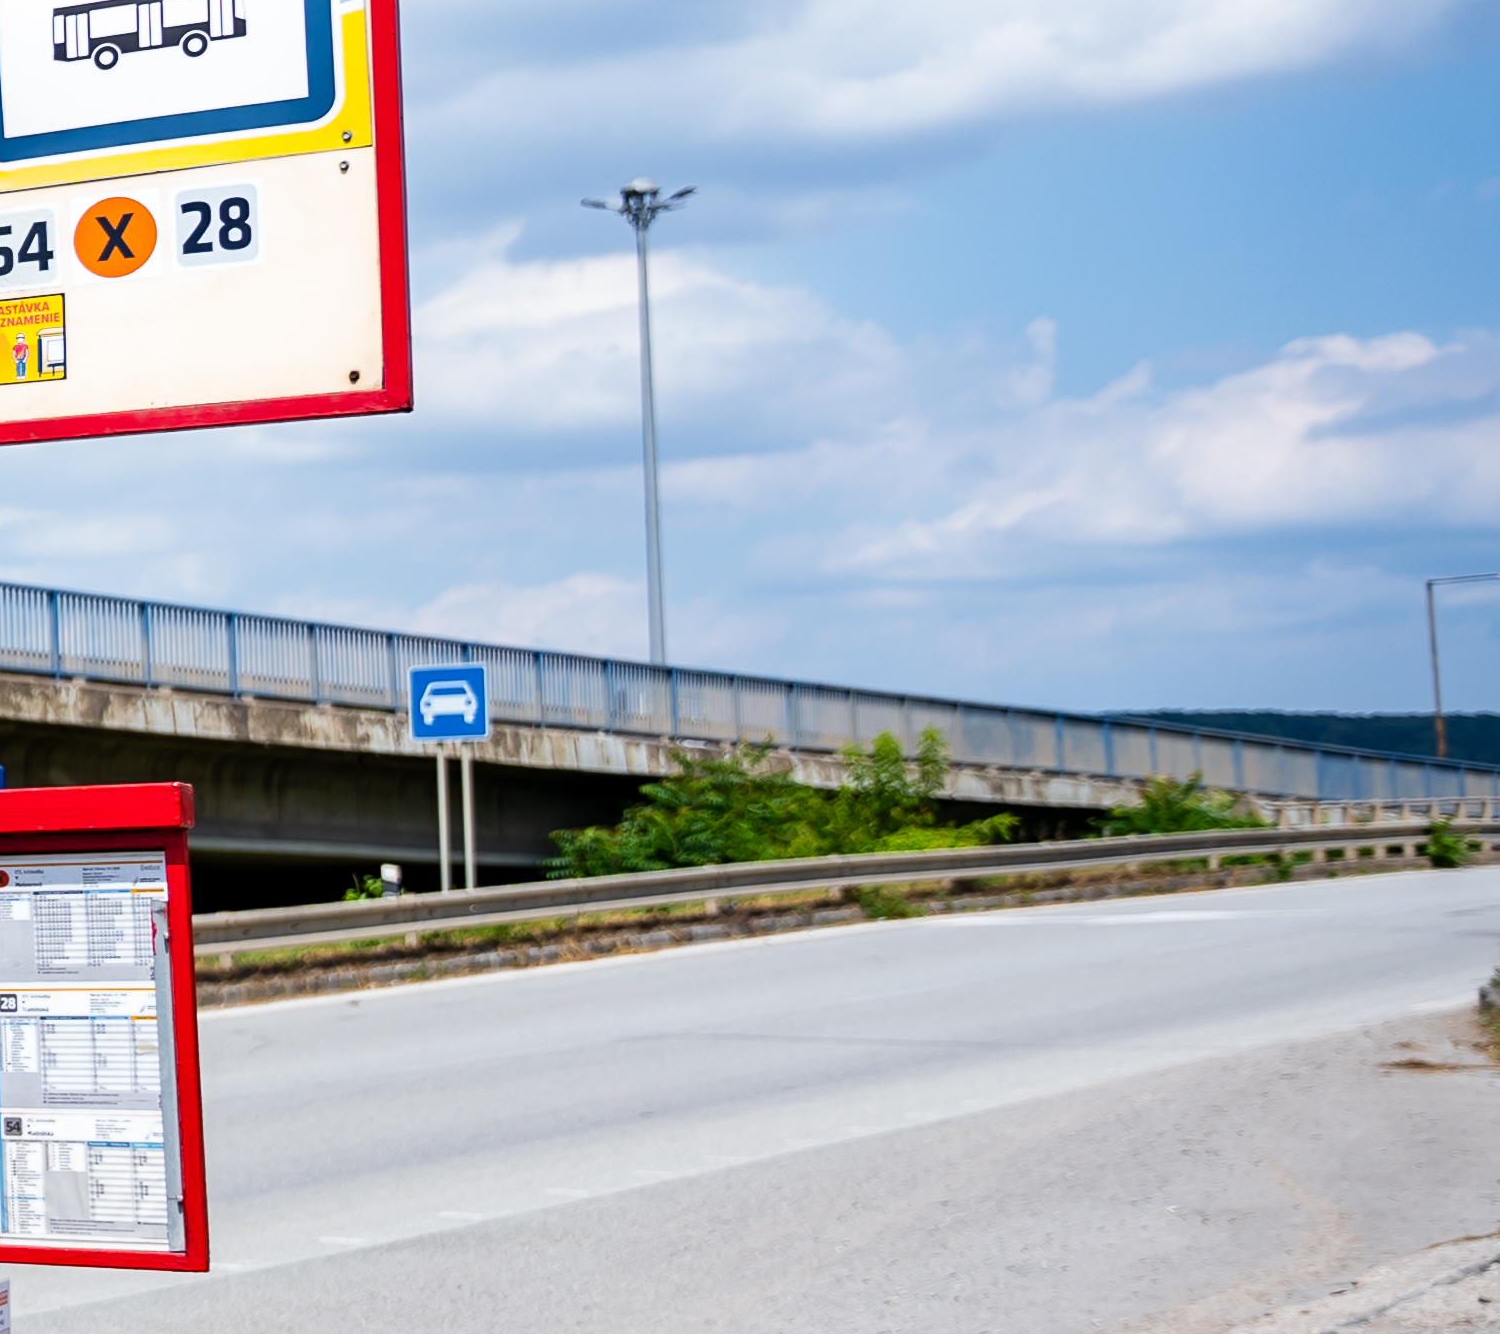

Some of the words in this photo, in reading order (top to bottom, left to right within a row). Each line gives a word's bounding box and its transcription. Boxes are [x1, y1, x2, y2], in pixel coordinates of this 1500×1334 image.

[95, 212, 135, 263] X
[180, 196, 252, 255] 28
[0, 312, 60, 328] ZNAMENIE
[0, 997, 16, 1010] 28
[6, 1120, 21, 1133] 54
